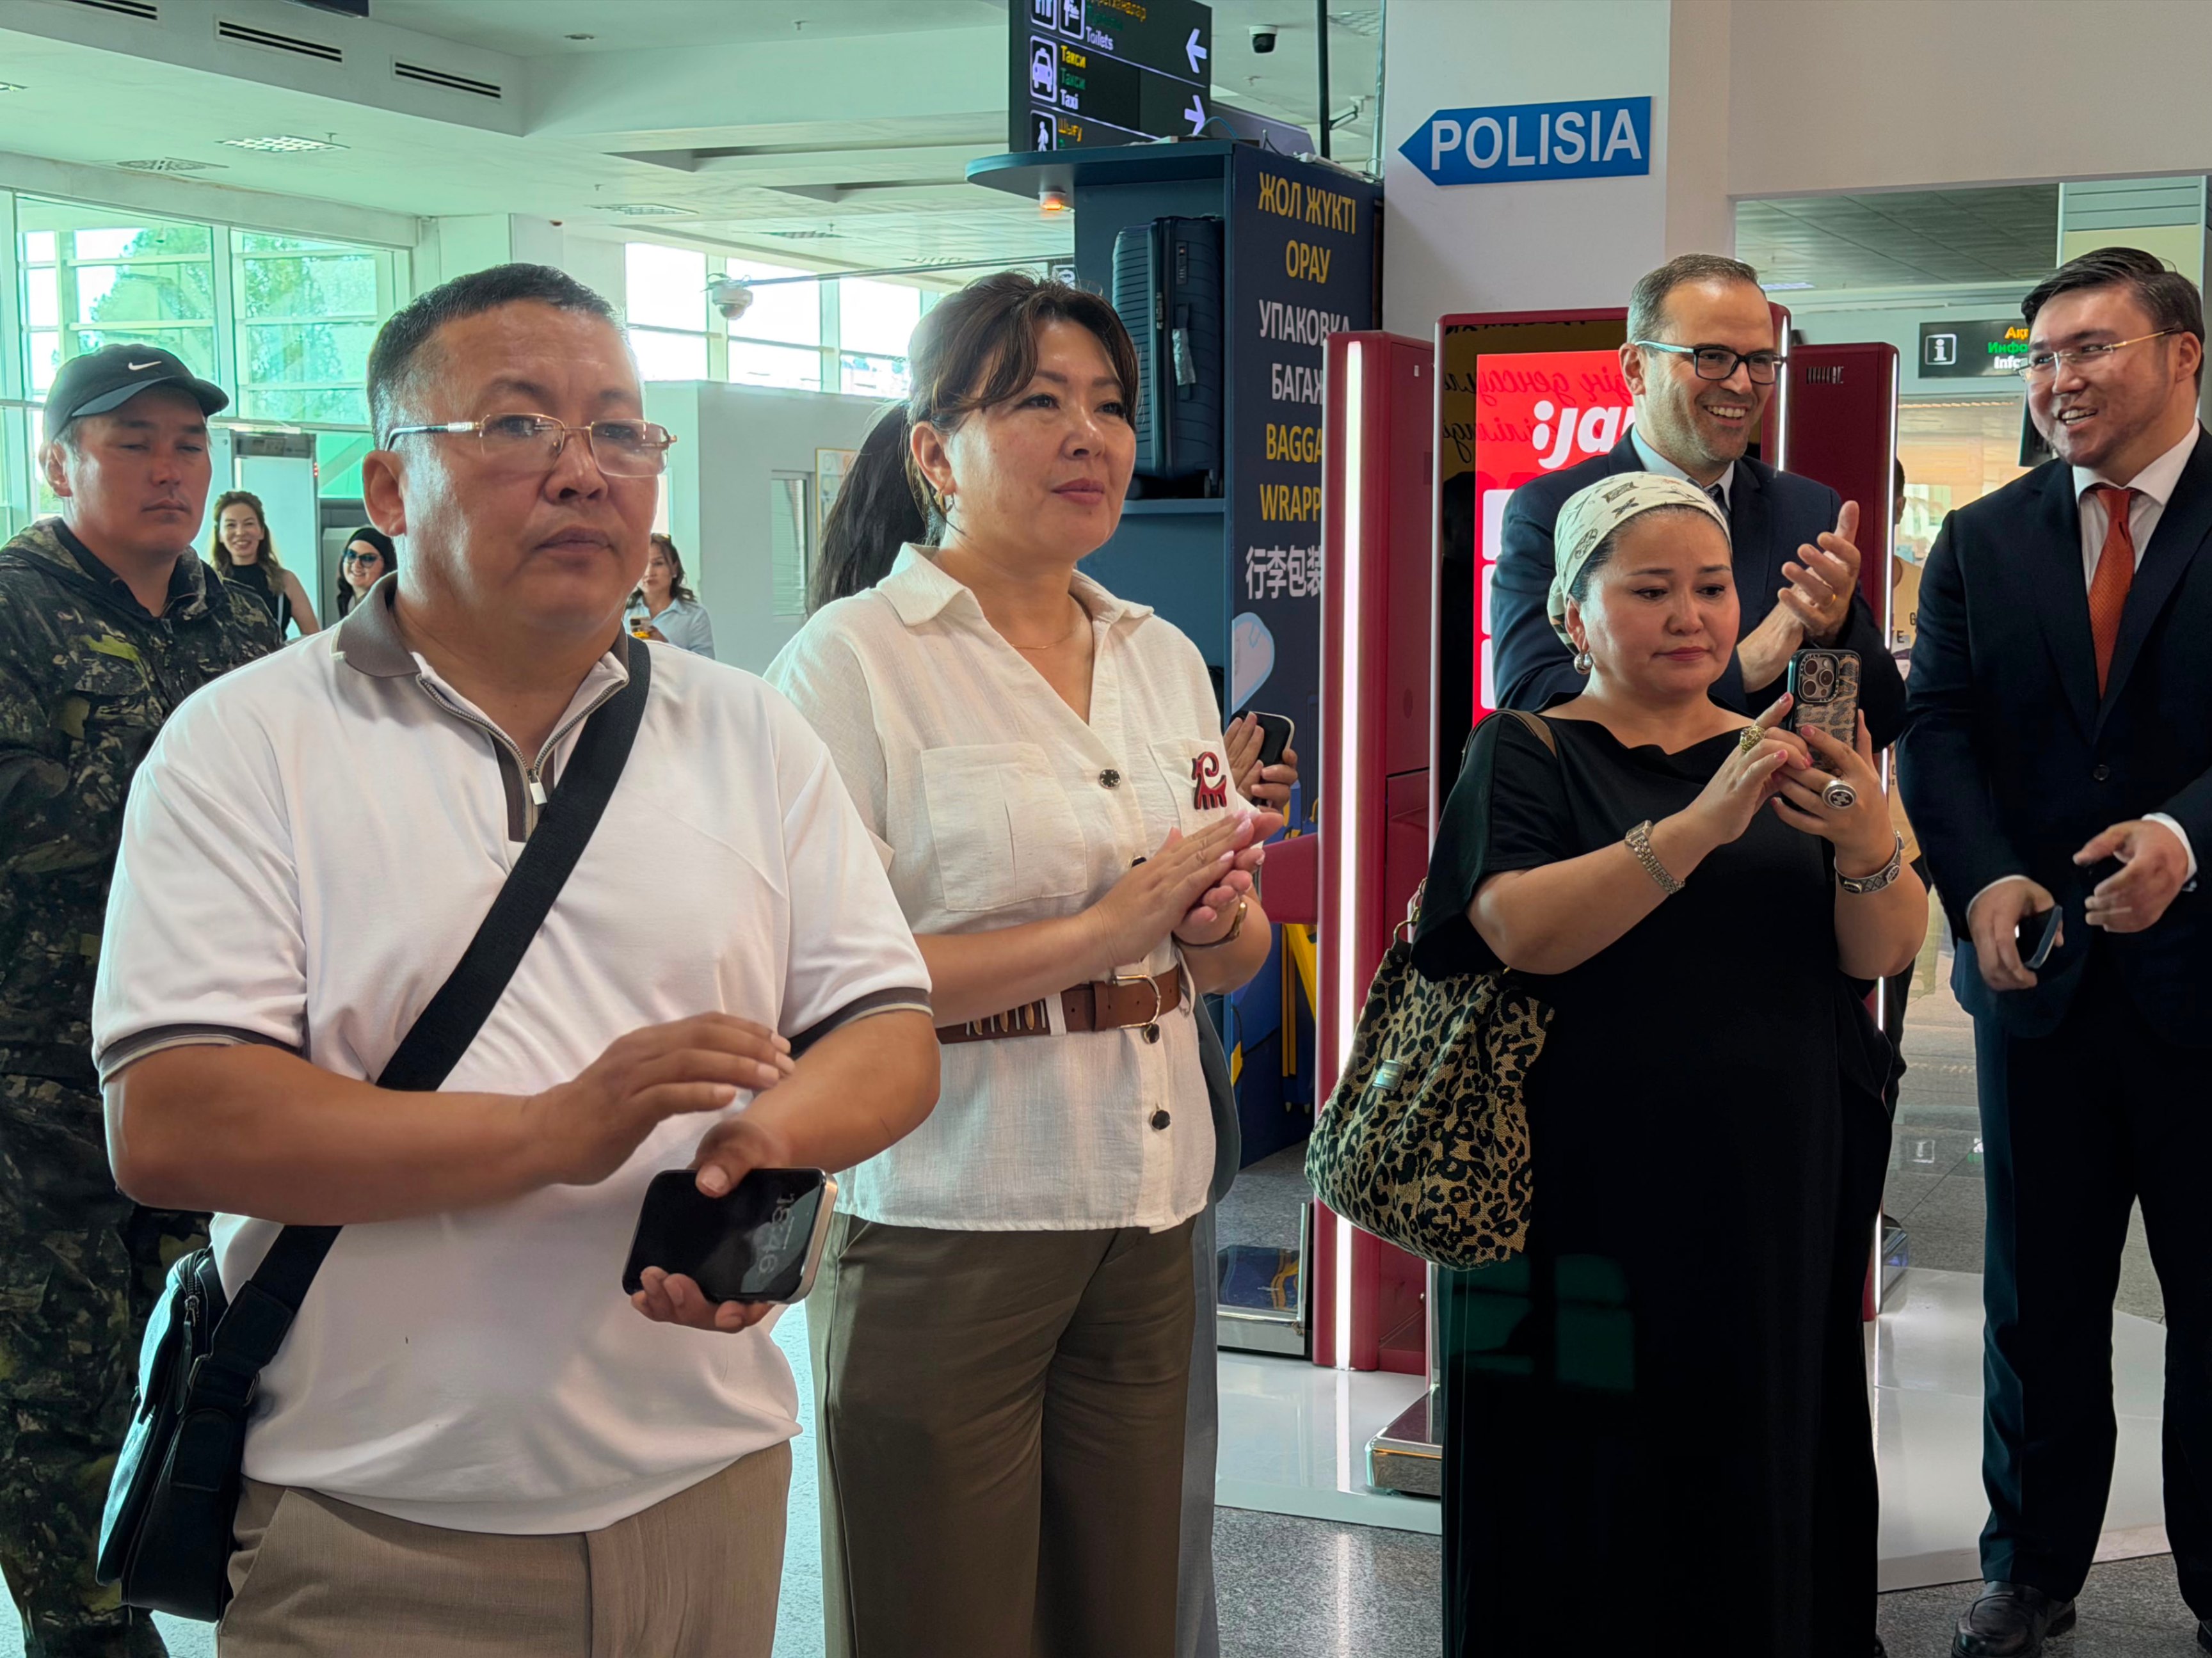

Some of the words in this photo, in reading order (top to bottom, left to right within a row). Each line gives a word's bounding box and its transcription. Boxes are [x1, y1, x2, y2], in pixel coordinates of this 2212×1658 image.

[1060, 45, 1087, 68] Такси
[1086, 26, 1114, 51] Toilets
[1060, 88, 1079, 110] Taxi
[1431, 109, 1642, 170] POLISIA
[1258, 171, 1301, 220] ЖОЛ
[1306, 186, 1356, 234] ЖҮКТІ
[1285, 239, 1331, 284] ОРАУ
[1987, 340, 2028, 355] Инфо
[1994, 355, 2021, 369] Info
[1272, 363, 1323, 405] БАГАЖ
[1266, 423, 1322, 463] BAGGA
[1260, 483, 1321, 522] WRAPP
